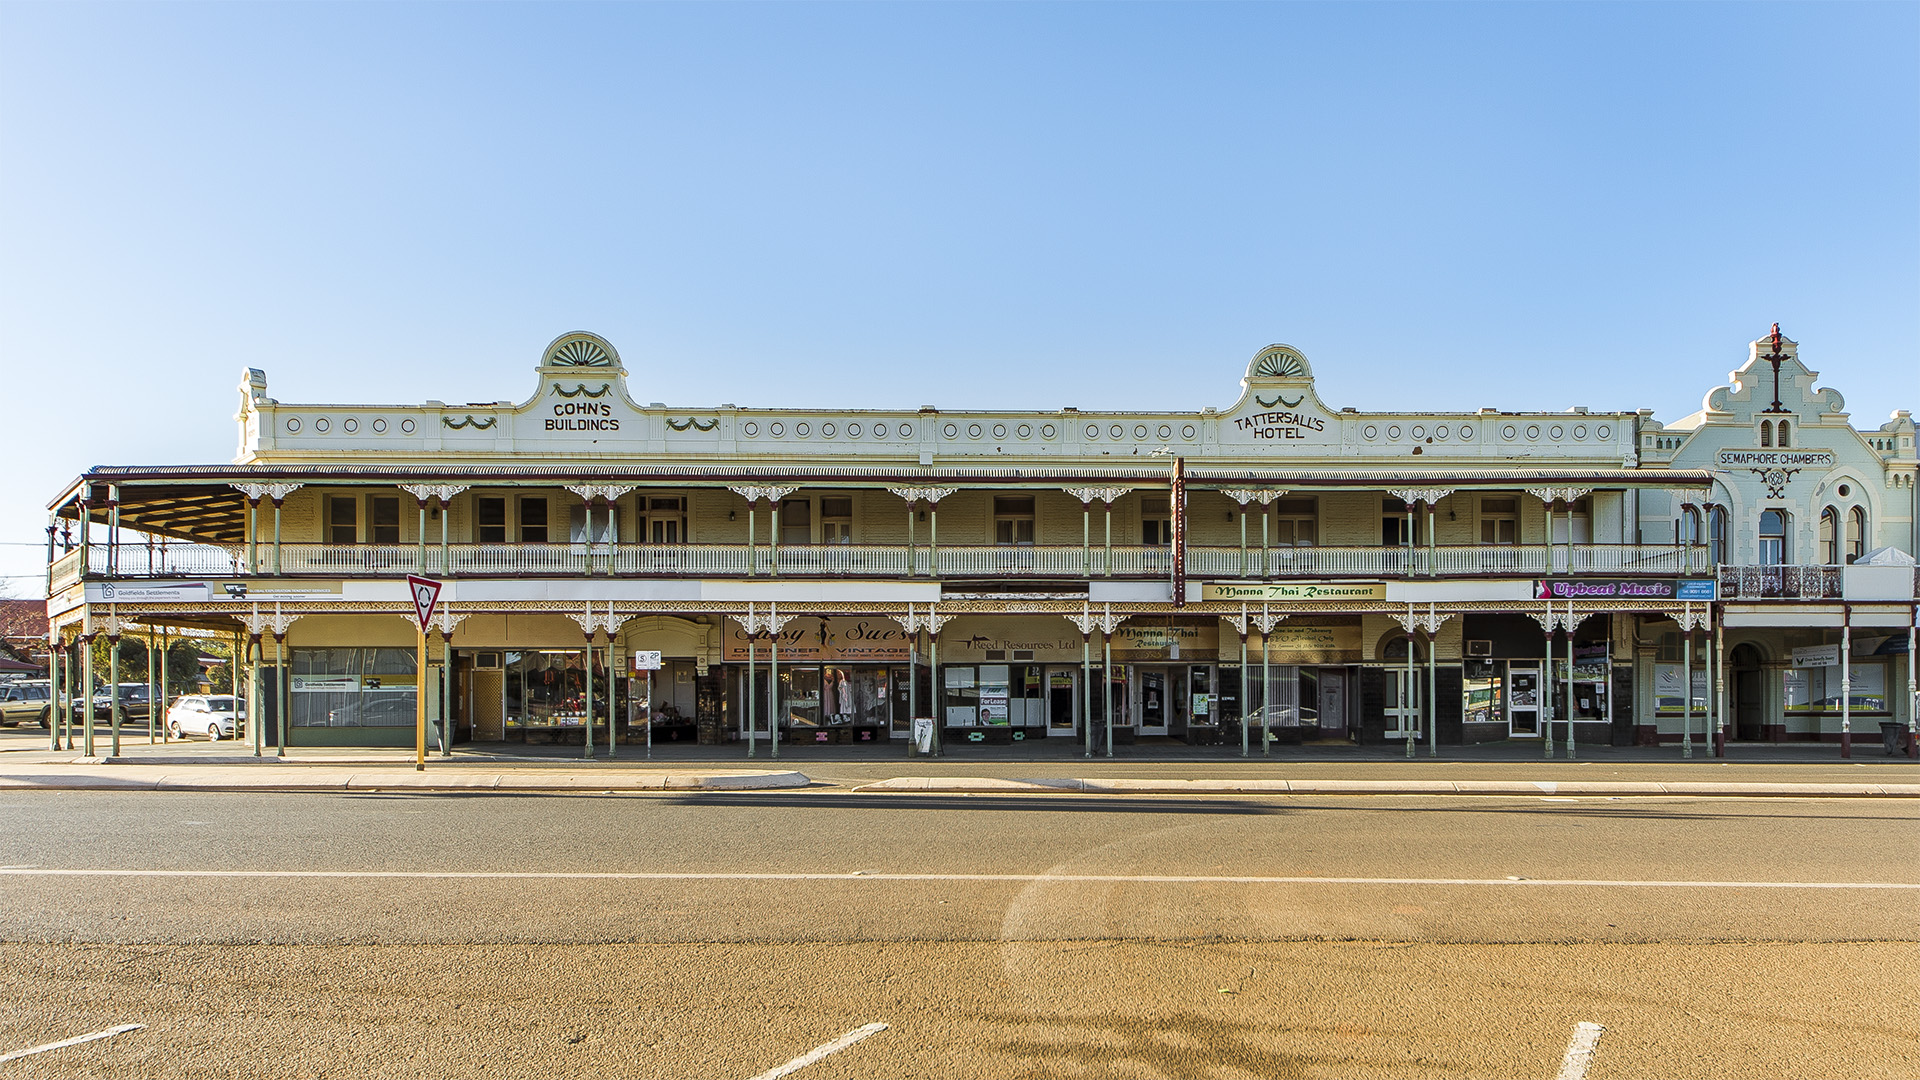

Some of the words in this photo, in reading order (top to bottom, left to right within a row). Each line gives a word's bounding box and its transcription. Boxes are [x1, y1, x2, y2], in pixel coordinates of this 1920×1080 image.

[553, 402, 612, 417] COHN'S
[1234, 411, 1325, 432] TATTERSALL'S
[1253, 427, 1305, 439] HOTEL
[1720, 453, 1778, 464] SEMAPHORE
[1779, 453, 1832, 465] CHAMBERS
[1215, 586, 1264, 598] Manna
[1268, 586, 1299, 598] Thai
[1303, 586, 1374, 598] Restaurant
[1553, 582, 1616, 597] Upbeat
[1619, 582, 1671, 596] Music
[735, 627, 805, 645] asy
[1117, 628, 1163, 640] Manna
[1168, 628, 1199, 640] Thai
[973, 640, 998, 650] Reed
[1003, 640, 1054, 650] Resources
[1058, 639, 1076, 650] Ltd
